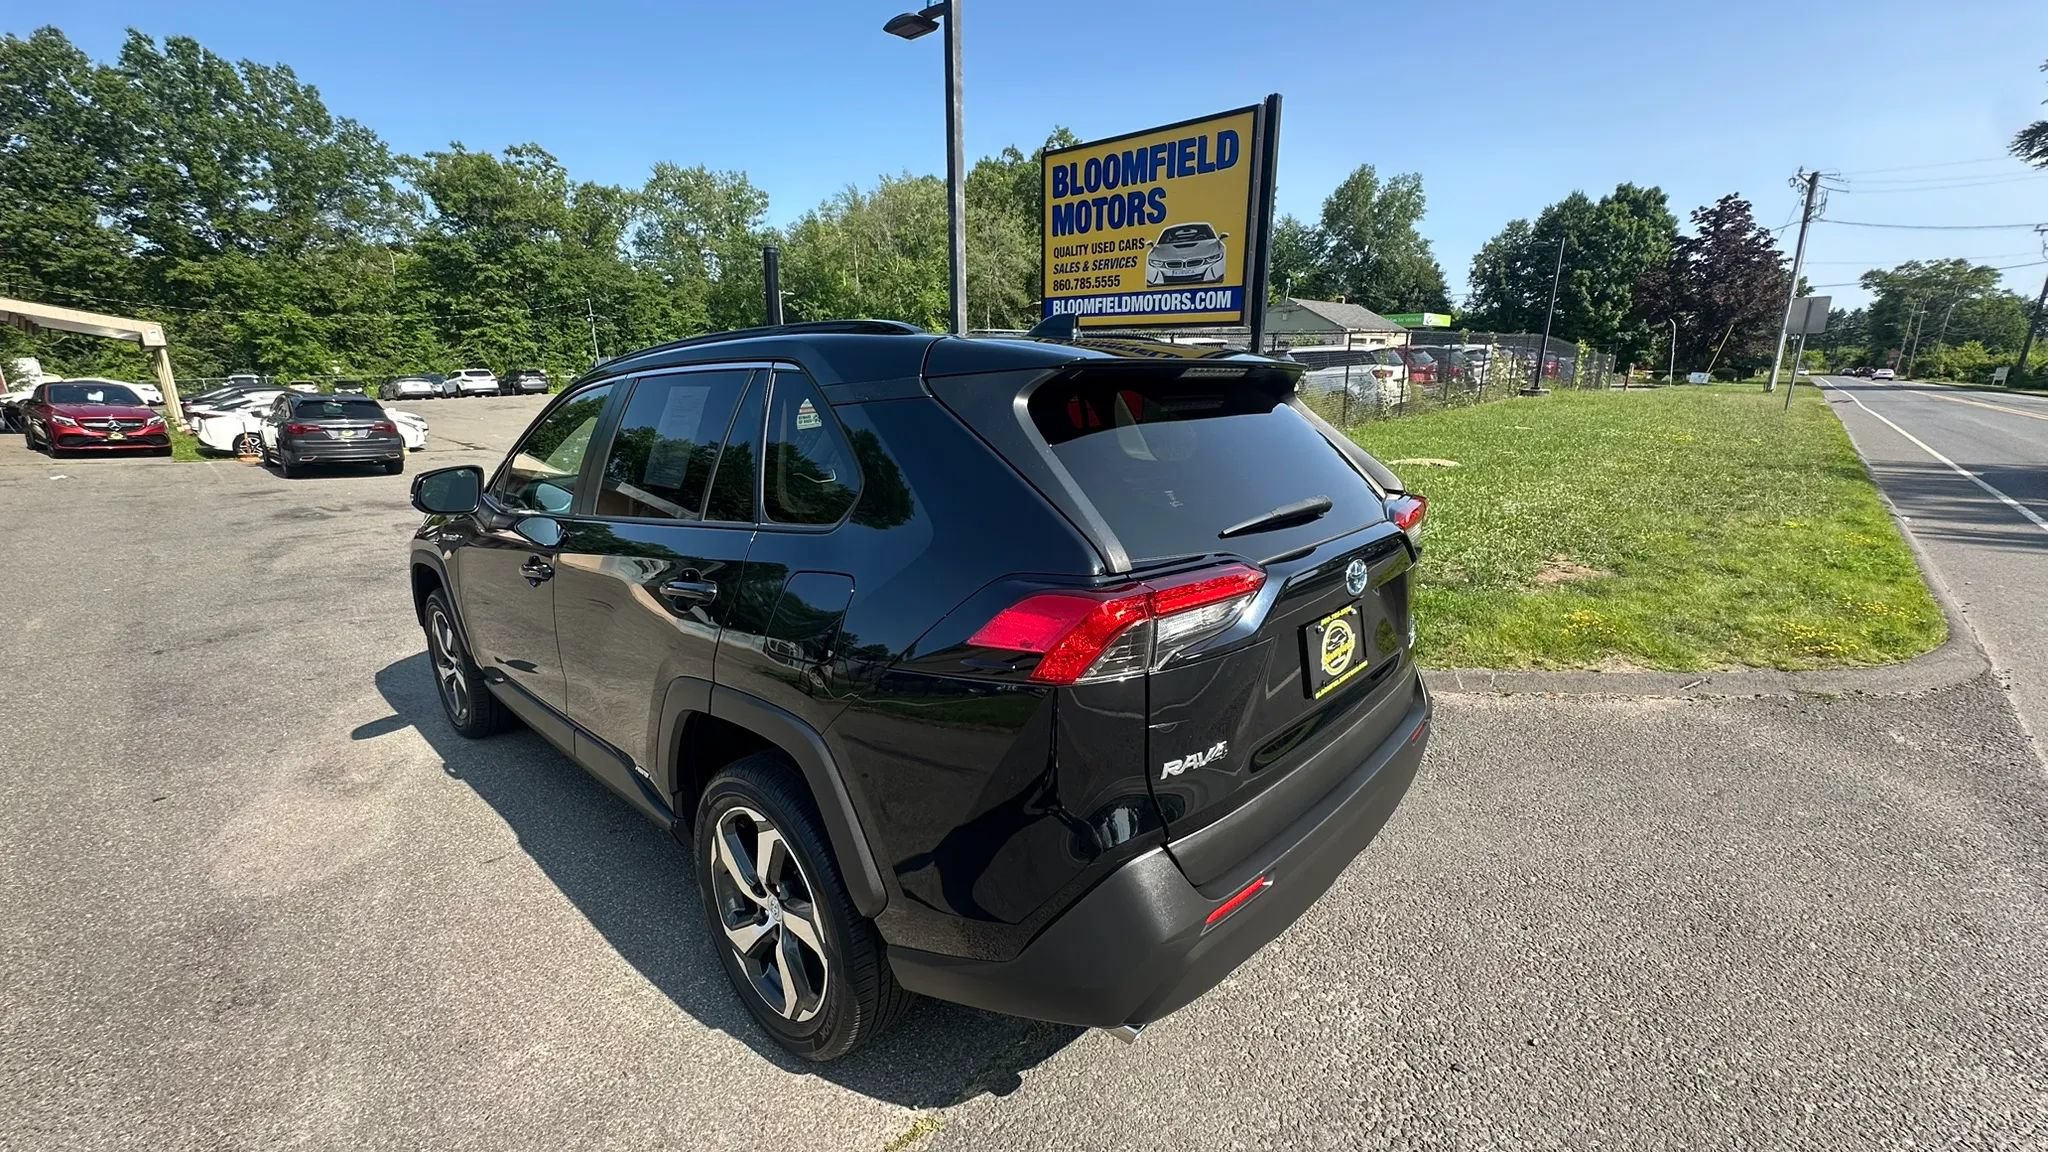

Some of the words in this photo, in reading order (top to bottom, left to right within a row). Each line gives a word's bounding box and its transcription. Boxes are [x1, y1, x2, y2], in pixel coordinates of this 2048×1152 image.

[1052, 129, 1240, 199] BLOOMFIELD
[1052, 187, 1167, 237] MOTORS
[1053, 244, 1088, 259] QUALITY
[1091, 241, 1115, 254] USED
[1118, 237, 1145, 252] CARS
[1053, 261, 1080, 275] SALES
[1082, 260, 1090, 272] &
[1092, 256, 1138, 271] SERVICES
[1053, 274, 1121, 292] 860.785.5555
[1052, 290, 1232, 316] BLOOMFIELDMOTORS.COM
[1160, 740, 1228, 780] RAV4
